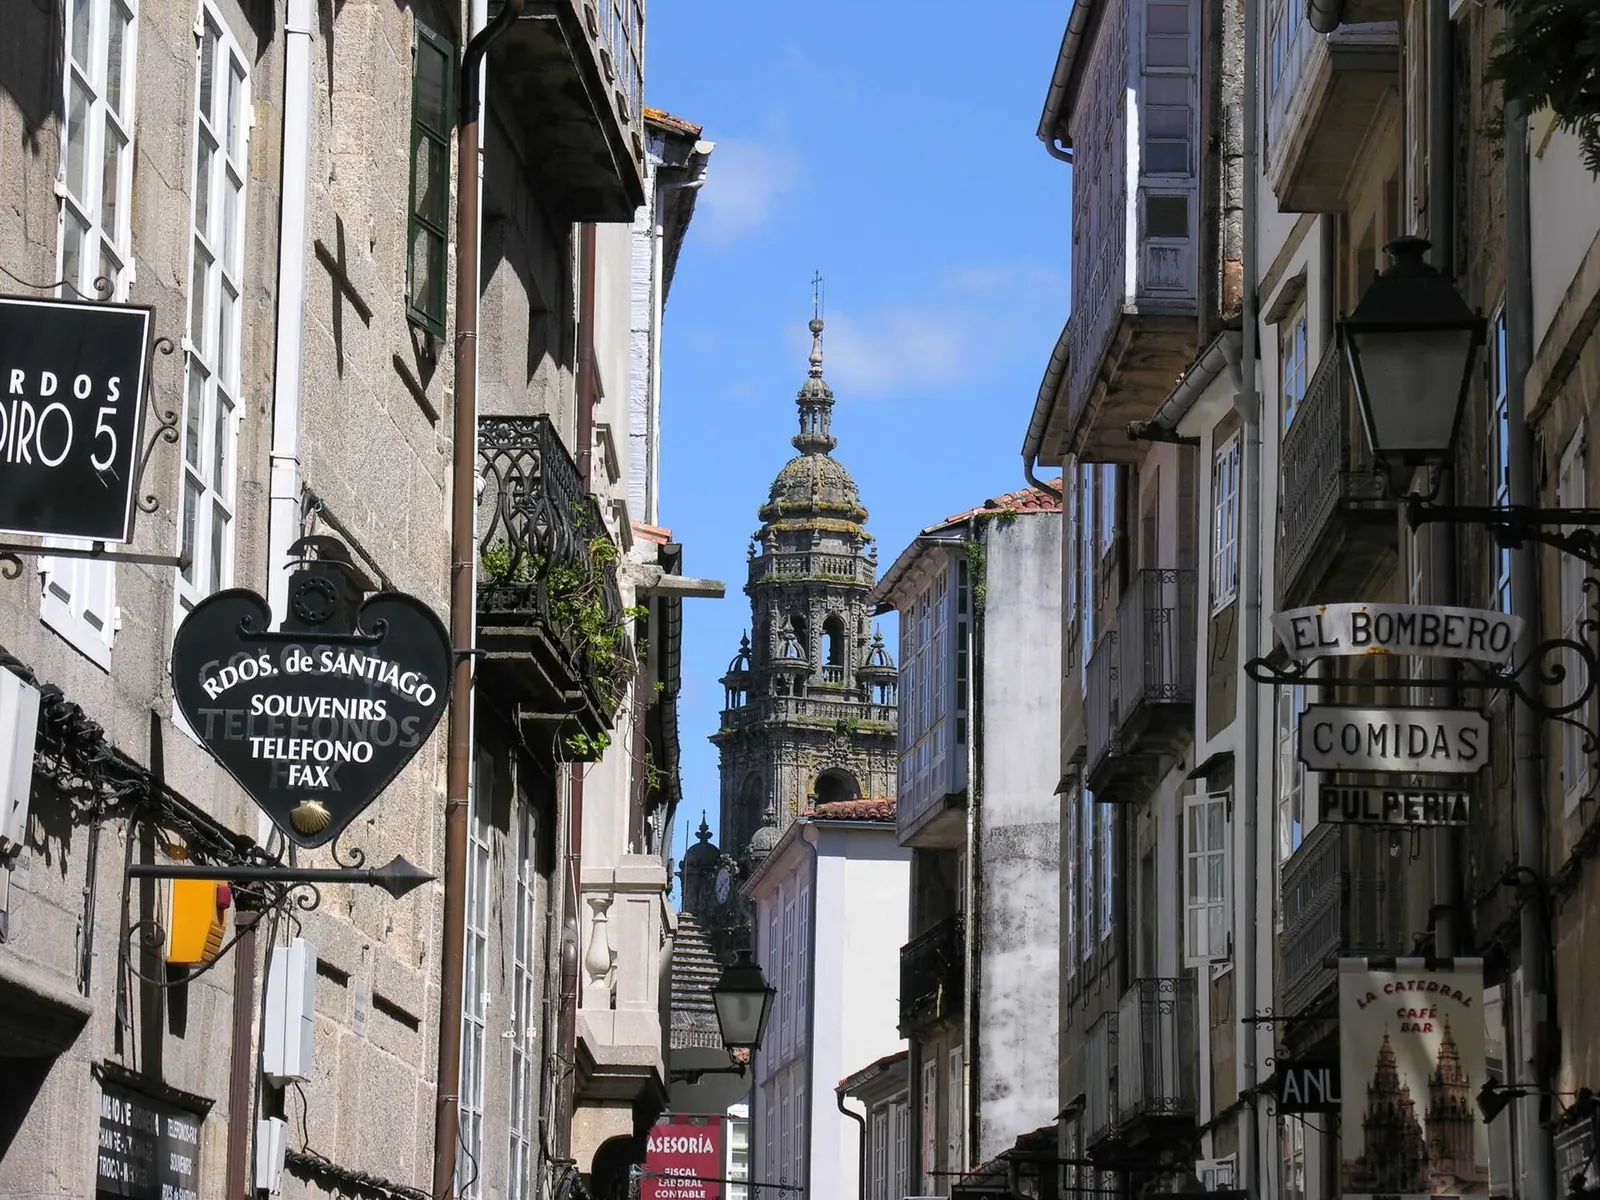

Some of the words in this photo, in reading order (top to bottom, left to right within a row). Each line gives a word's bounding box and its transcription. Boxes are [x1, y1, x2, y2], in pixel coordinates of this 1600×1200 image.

[90, 406, 117, 471] 5
[1290, 614, 1340, 650] EL
[1350, 611, 1512, 653] BOMBERO
[202, 654, 279, 700] RDOS.
[285, 650, 313, 673] de
[320, 651, 437, 708] SANTIAGO
[250, 694, 387, 722] SOUVENIRS
[249, 737, 374, 763] TELEFONO
[1312, 722, 1479, 761] COMIDAS
[288, 765, 330, 788] FAX
[1322, 788, 1469, 822] PULPERIA
[1356, 991, 1377, 1010] LA
[1383, 980, 1473, 1008] CATEDRAL
[1396, 1004, 1437, 1019] CAFÉ
[1401, 1022, 1433, 1033] BAR
[646, 1133, 714, 1154] ASESORÍA
[658, 1179, 703, 1188] LABORAL
[664, 1168, 697, 1176] FISCAL
[655, 1190, 706, 1199] CONTABLE
